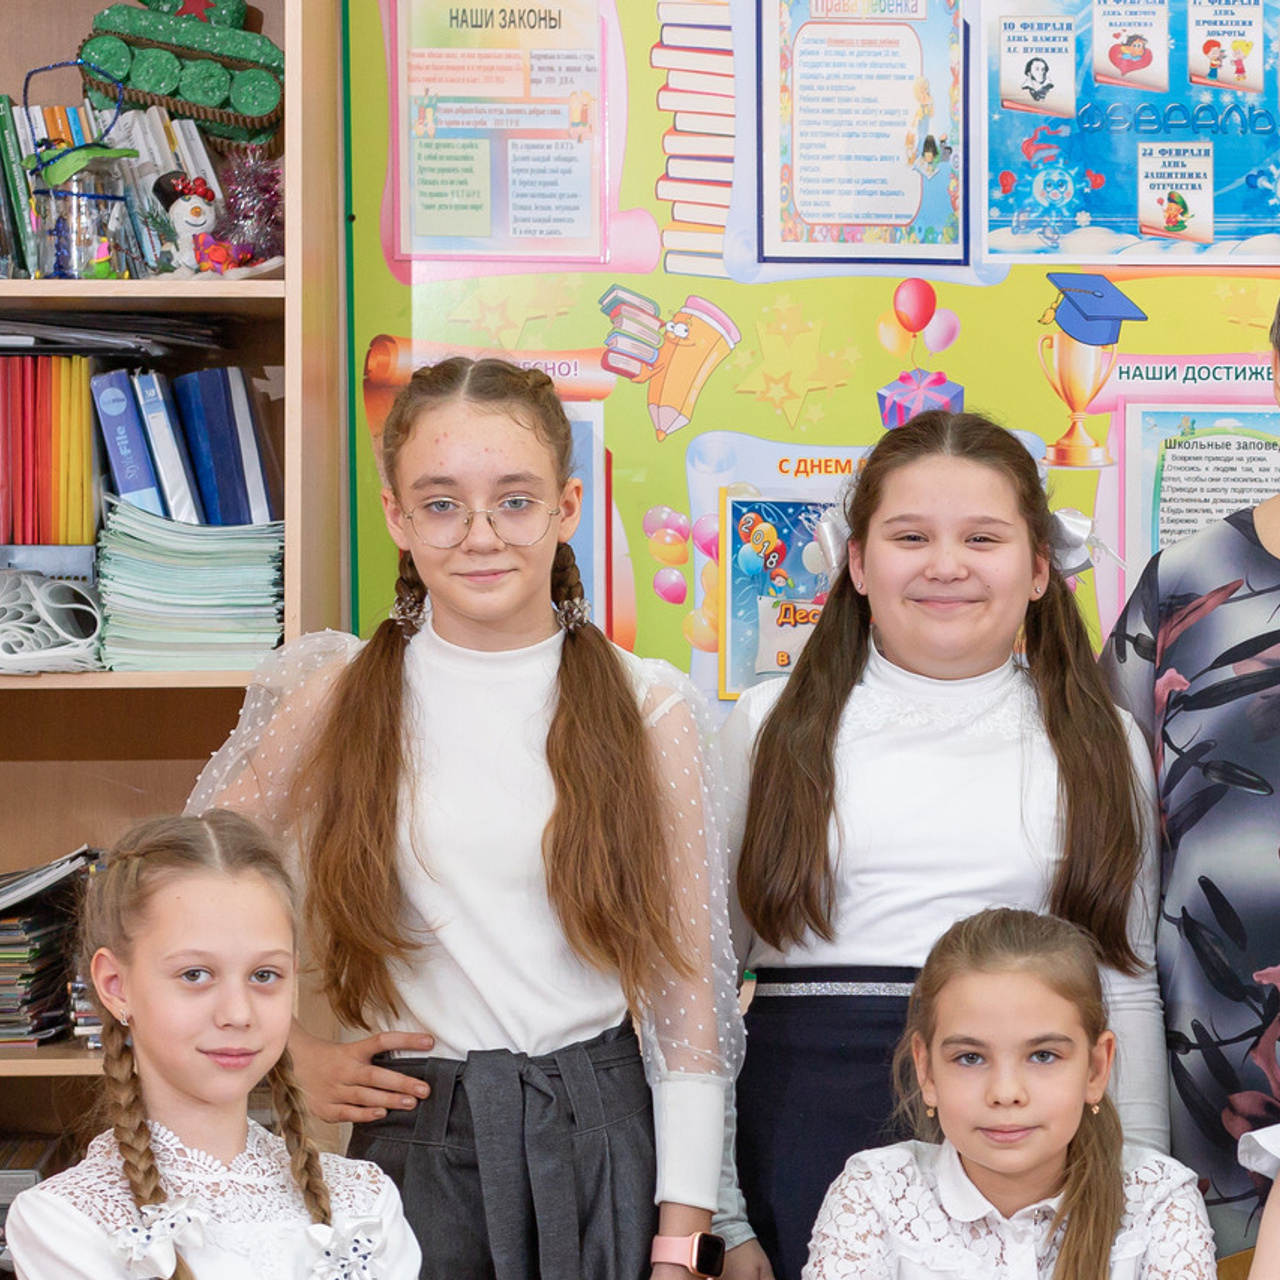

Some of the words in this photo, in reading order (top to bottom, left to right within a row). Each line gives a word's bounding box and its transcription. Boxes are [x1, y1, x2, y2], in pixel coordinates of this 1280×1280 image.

[449, 8, 495, 29] НАШИ
[498, 8, 562, 30] ЗАКОНЫ
[1003, 22, 1016, 31] 10
[1020, 22, 1073, 31] ФЕВРАЛЯ
[1206, 29, 1245, 37] ДОБРОТЫ
[1077, 102, 1277, 135] ФЕВРАЛЬ
[1158, 149, 1211, 157] ФЕВРАЛЯ
[1161, 160, 1187, 168] ДЕНЬ
[1118, 365, 1177, 381] НАШИ
[1182, 365, 1274, 384] ДОСТИЖЕ
[1164, 439, 1232, 451] Школьные
[1204, 455, 1234, 463] приходи
[779, 459, 790, 474] С
[795, 459, 852, 477] ДНЕМ
[1212, 464, 1238, 473] людям
[1222, 475, 1264, 483] относились
[1206, 486, 1228, 494] школу
[1211, 496, 1250, 505] домашним
